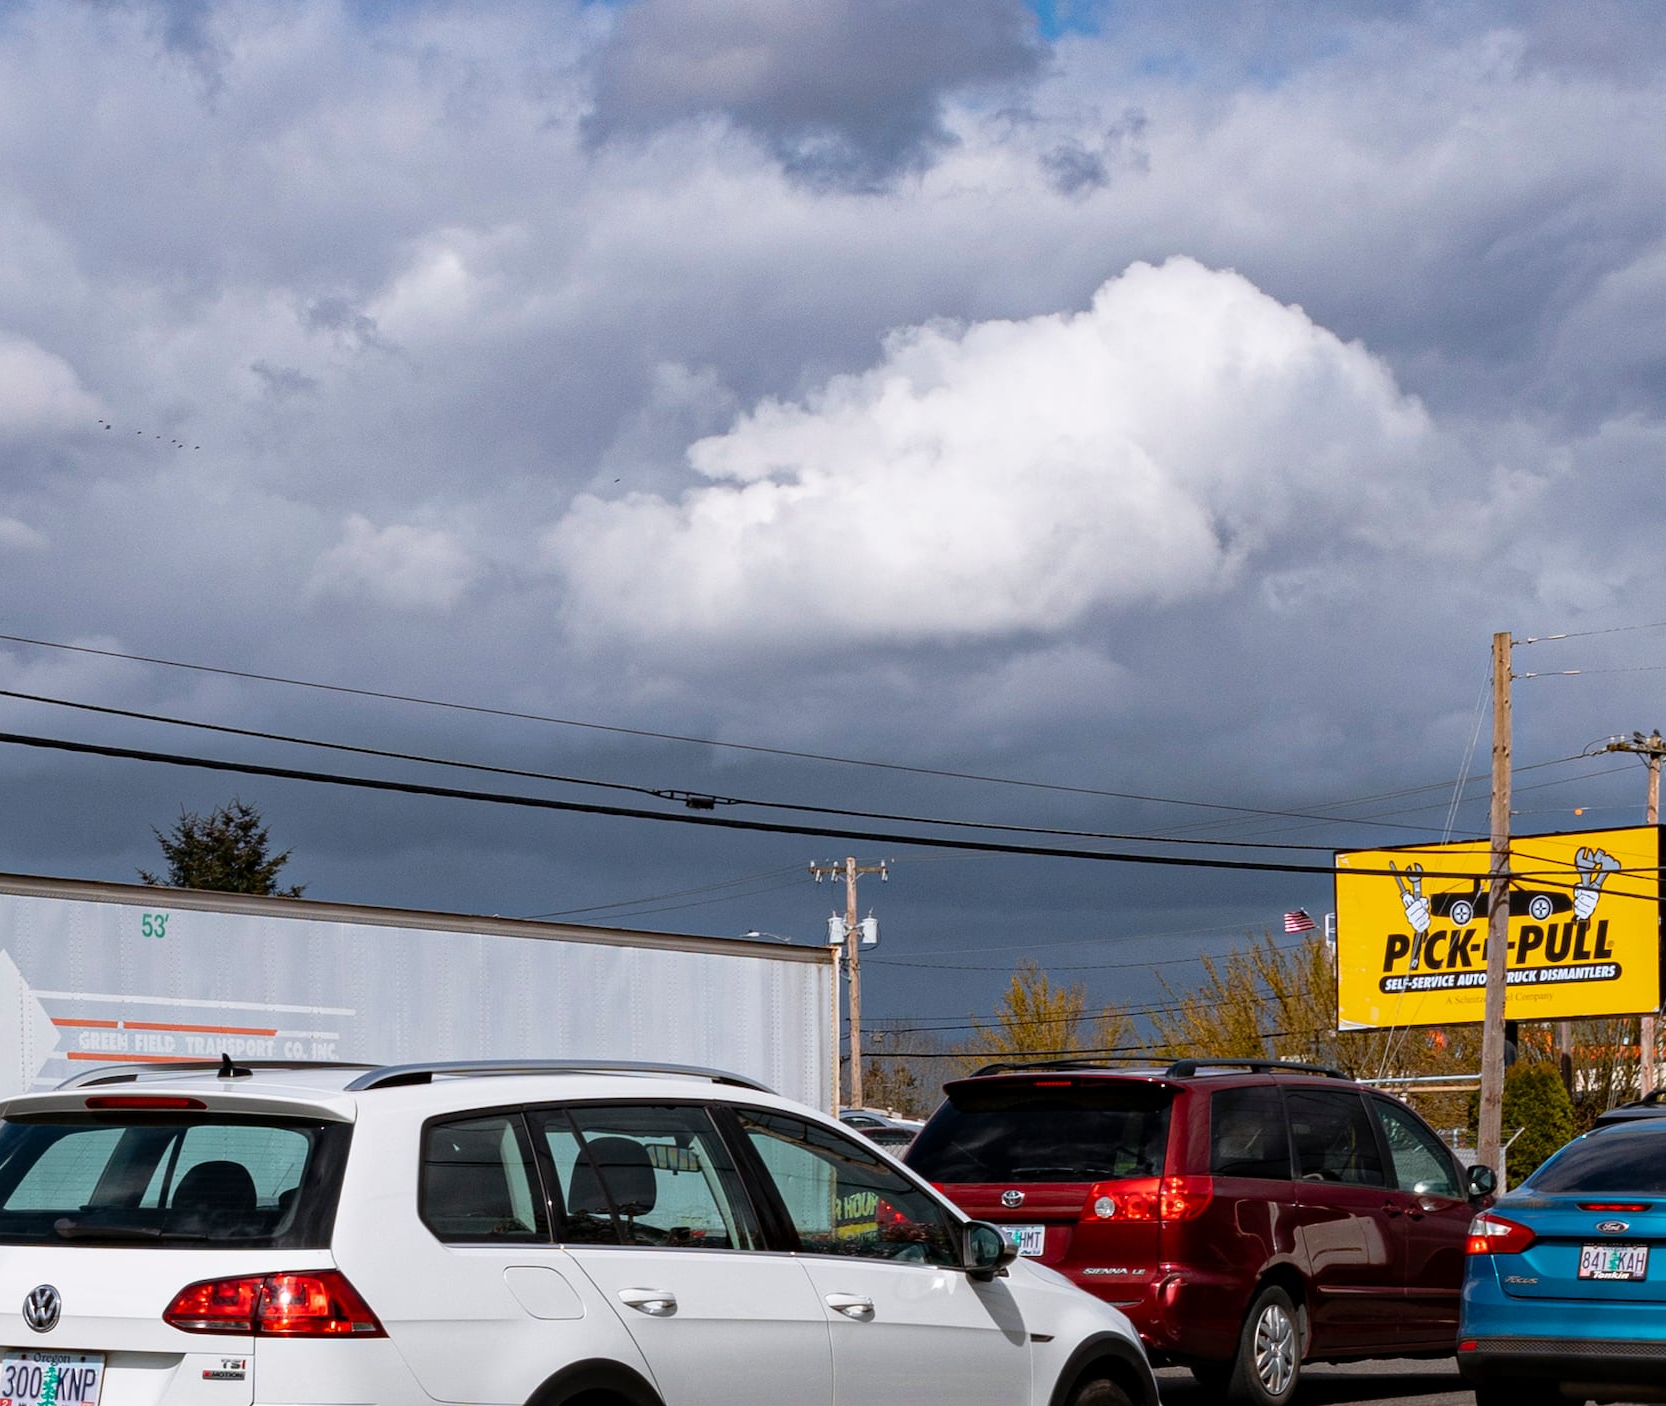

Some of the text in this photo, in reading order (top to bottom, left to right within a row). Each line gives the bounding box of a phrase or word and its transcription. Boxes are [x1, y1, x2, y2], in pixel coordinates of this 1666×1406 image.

[1383, 919, 1613, 973] PICK--PULL
[1384, 965, 1616, 991] SELF-SERVICE AUTO RUCK DISMANTLERS
[78, 1031, 129, 1051] GREEN
[134, 1033, 176, 1053] FIELD
[185, 1035, 276, 1057] TRANSPORT
[284, 1041, 307, 1059] CO.
[1019, 1231, 1041, 1249] HMT
[1083, 1267, 1128, 1275] SIENNA
[1582, 1251, 1645, 1272] 841 KAH
[1593, 1271, 1630, 1280] Tonkin
[33, 1352, 71, 1367] Oregon
[2, 1365, 96, 1402] 300 KNP
